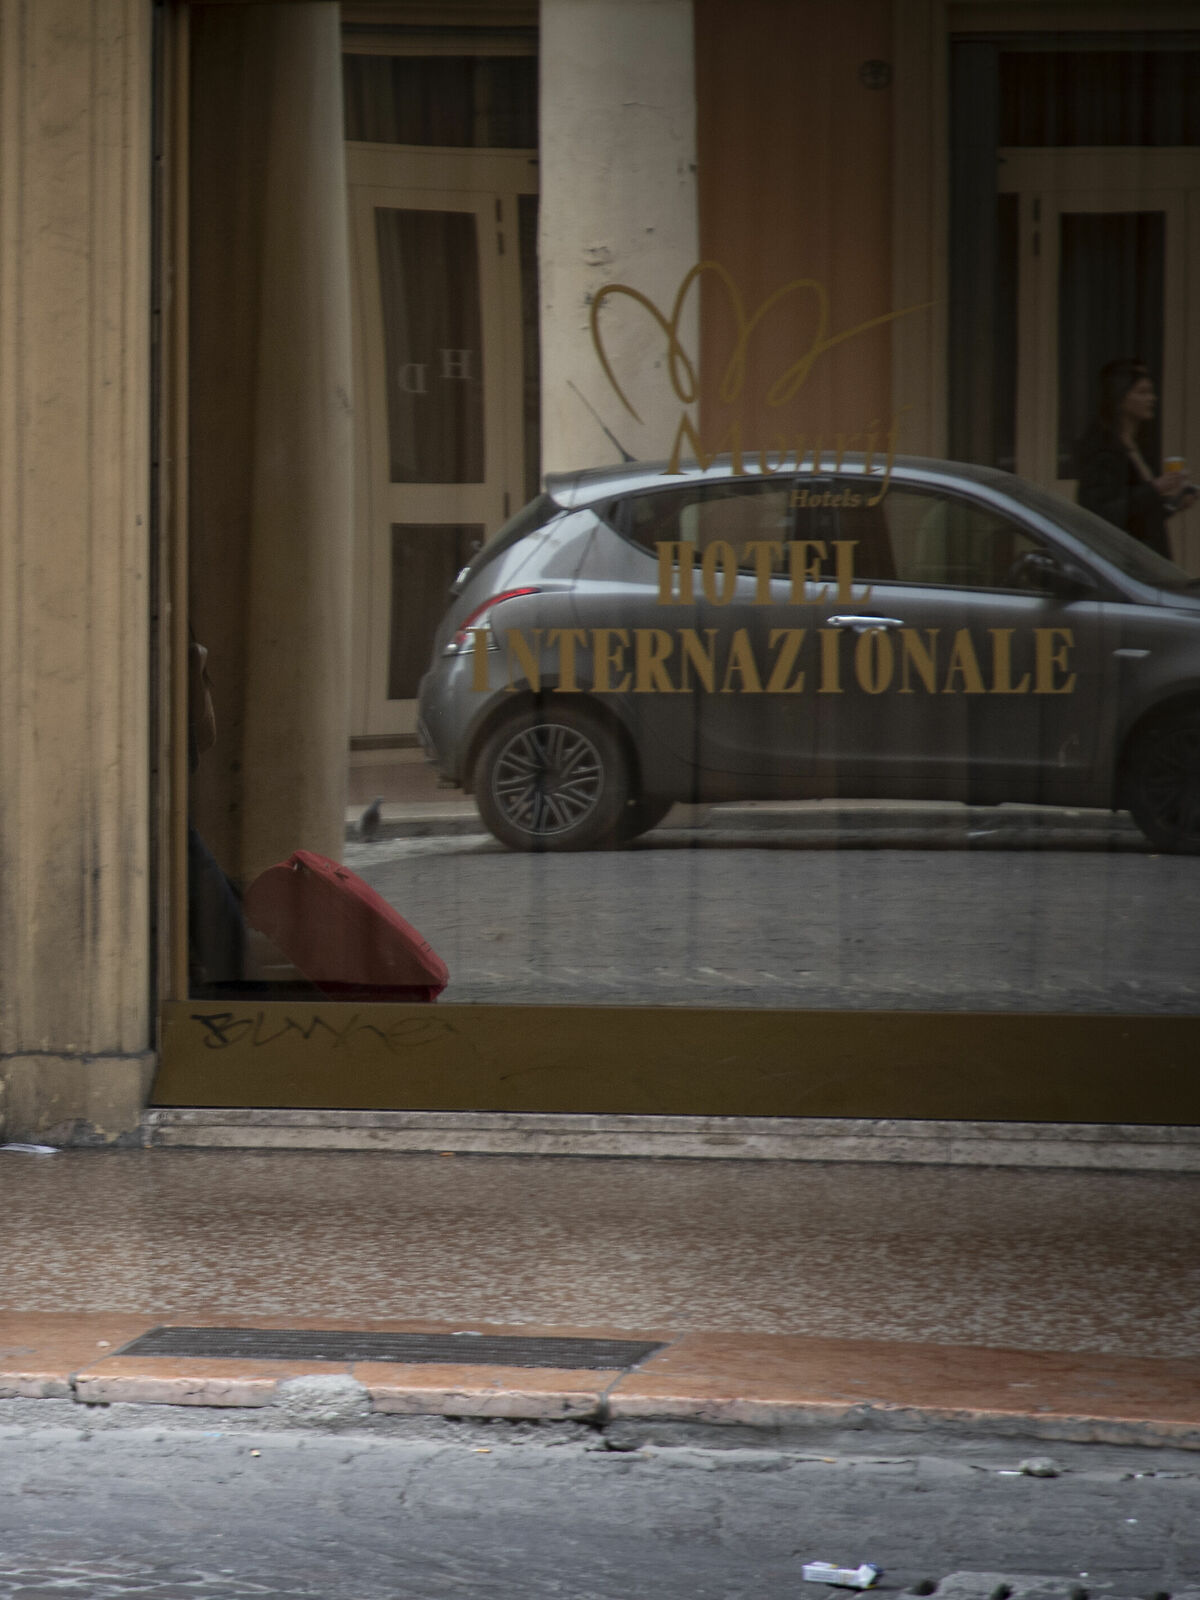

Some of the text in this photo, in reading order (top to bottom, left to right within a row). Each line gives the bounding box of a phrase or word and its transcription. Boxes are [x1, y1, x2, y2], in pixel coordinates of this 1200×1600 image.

[789, 487, 862, 509] Hotels
[655, 539, 872, 607] HOTEL
[469, 627, 1077, 695] INTERNAZIONALE
